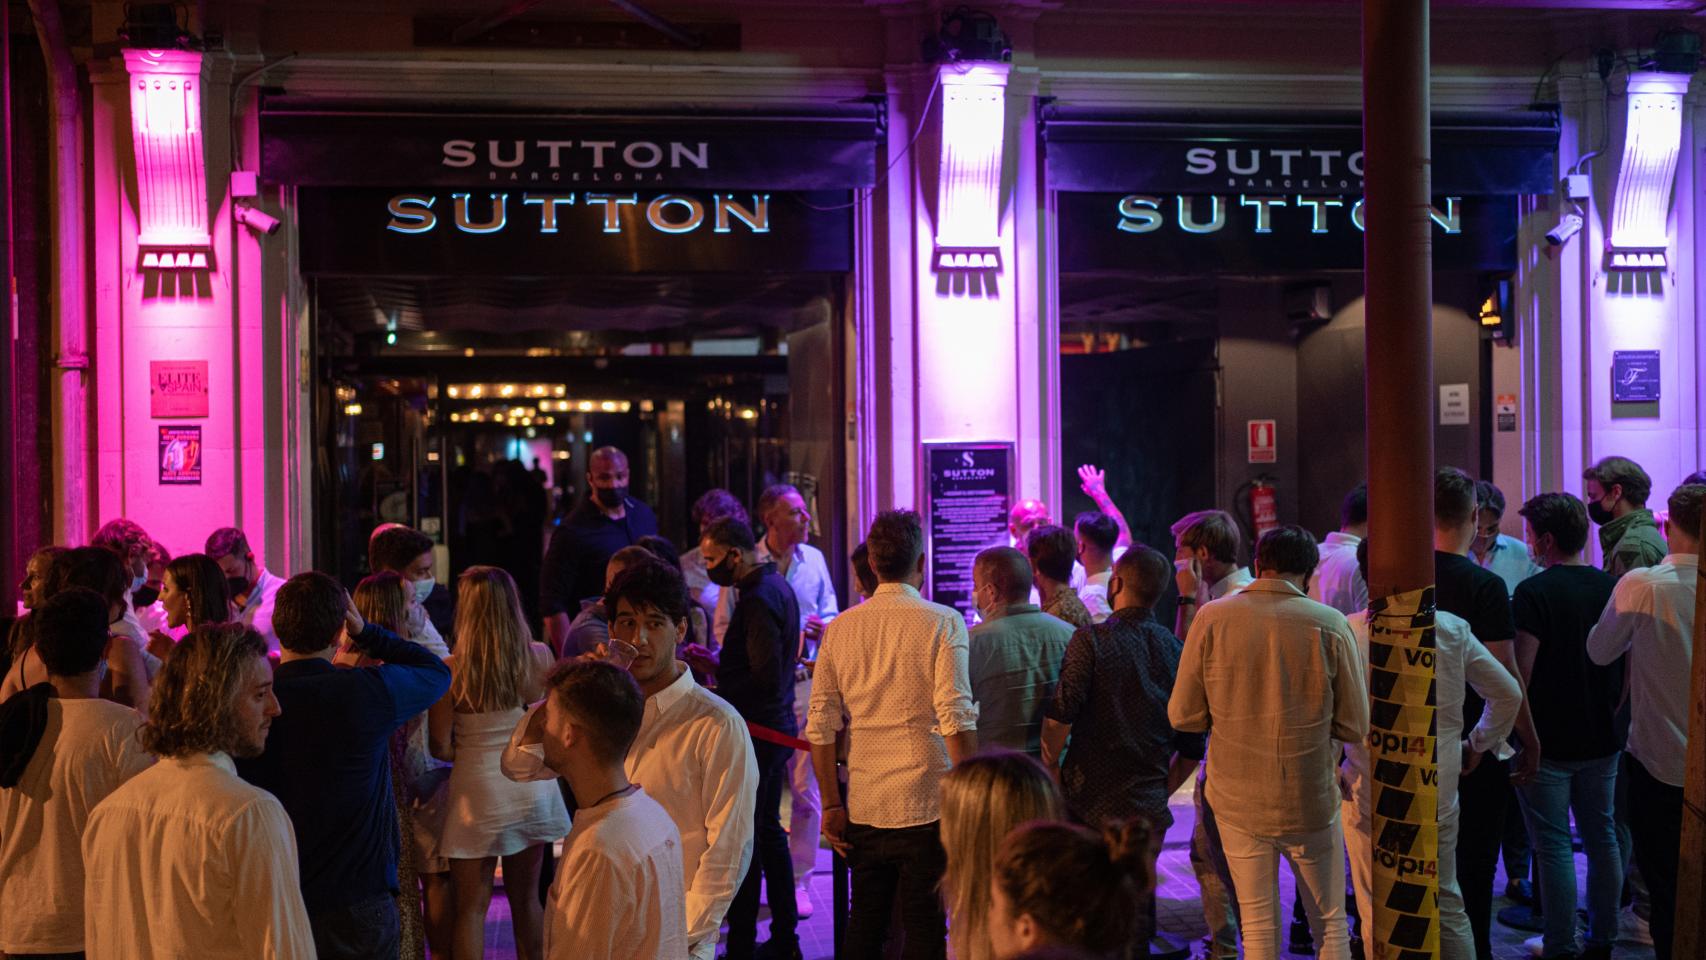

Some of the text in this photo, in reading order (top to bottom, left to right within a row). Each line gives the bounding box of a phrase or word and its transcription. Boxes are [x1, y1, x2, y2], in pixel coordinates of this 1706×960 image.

[442, 140, 709, 169] SUTTON
[489, 172, 663, 182] BARCELONA
[386, 193, 771, 234] SUTTON
[1117, 194, 1462, 234] SUTTN
[158, 372, 201, 385] ELITE
[167, 382, 202, 393] SPAIN
